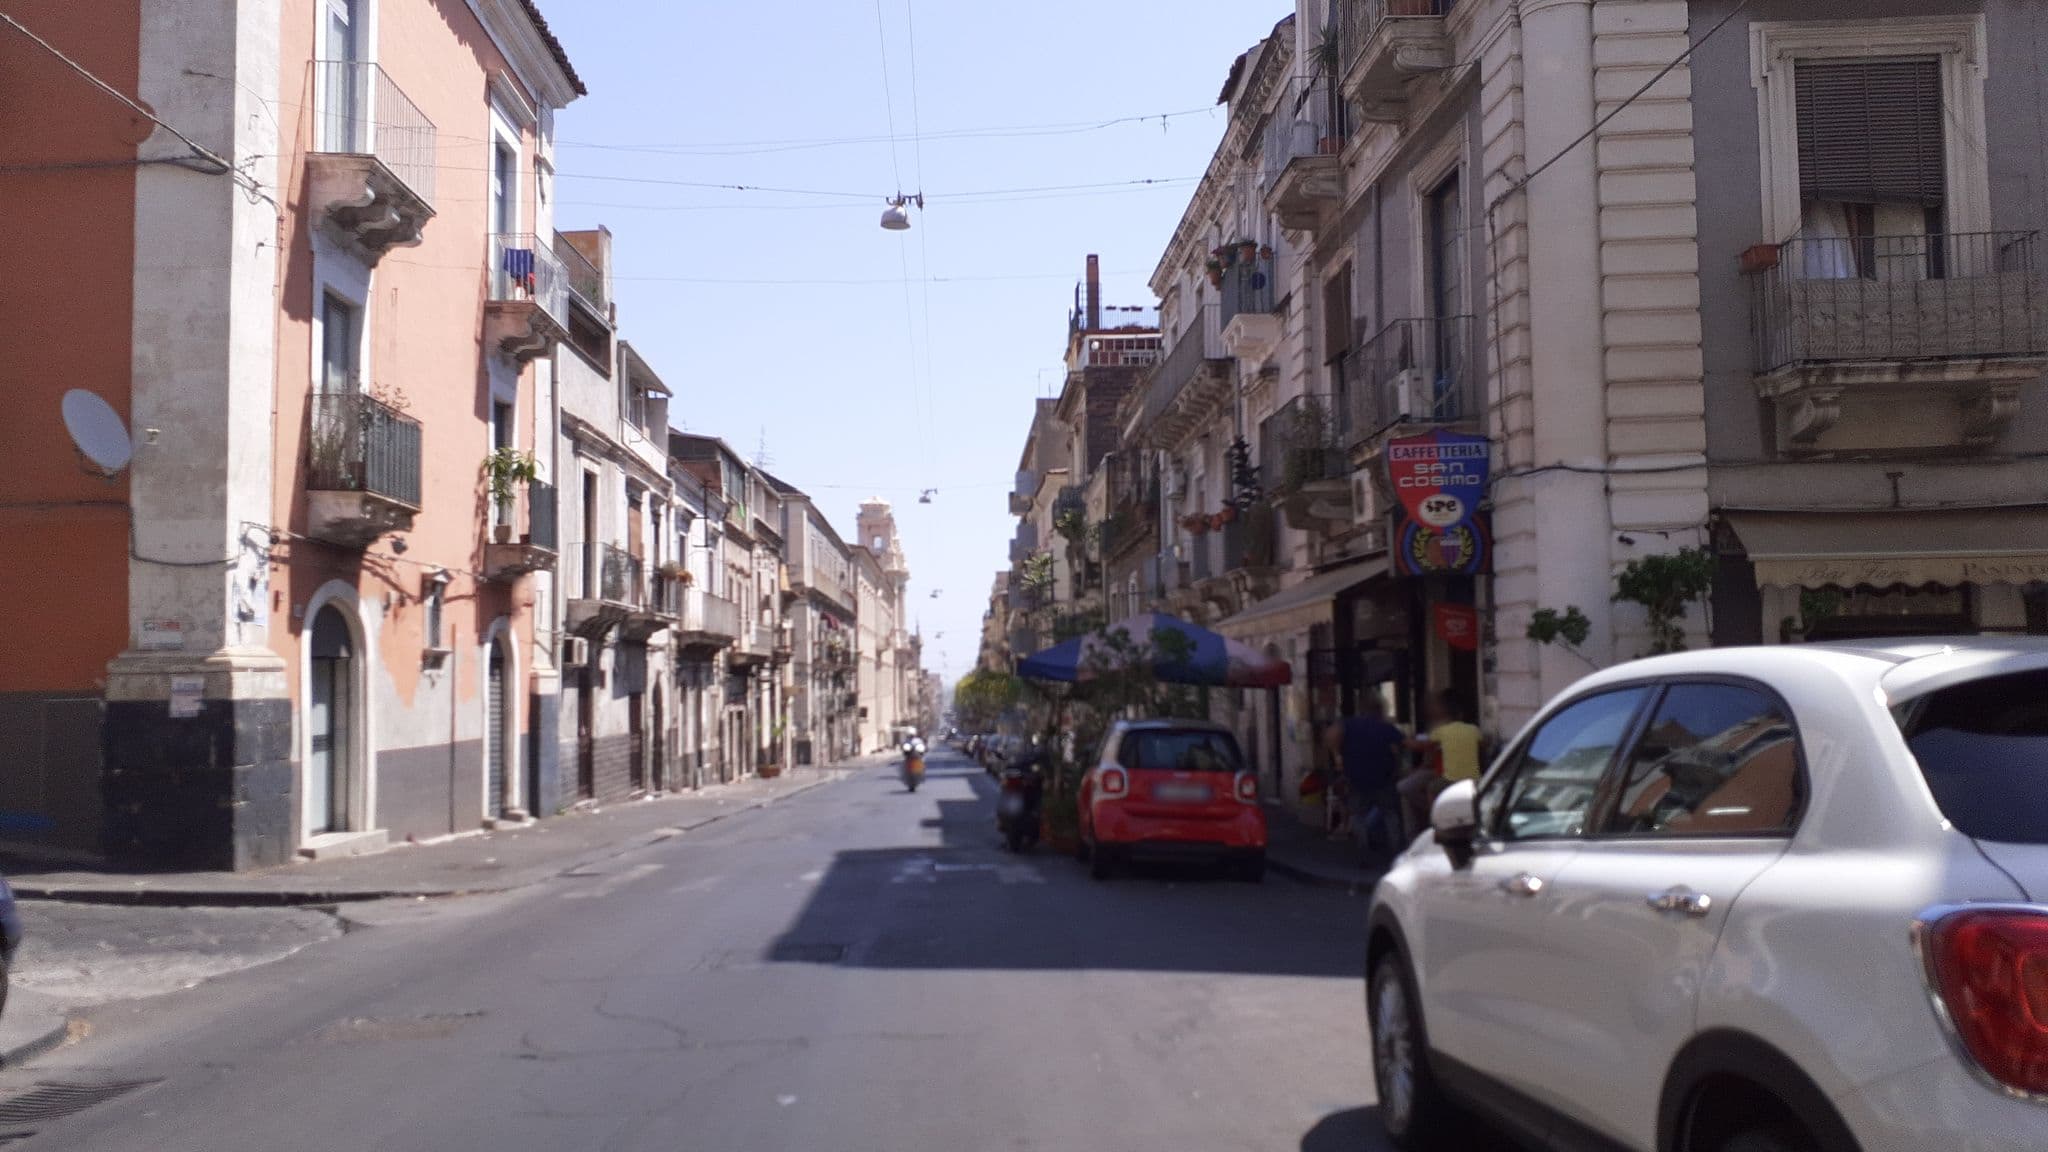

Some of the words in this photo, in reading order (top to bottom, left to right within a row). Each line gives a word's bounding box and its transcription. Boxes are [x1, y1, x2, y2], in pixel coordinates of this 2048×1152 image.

[1393, 445, 1481, 459] CAFFETTERIA
[1414, 462, 1464, 474] SAN
[1399, 474, 1480, 487] COSIMO
